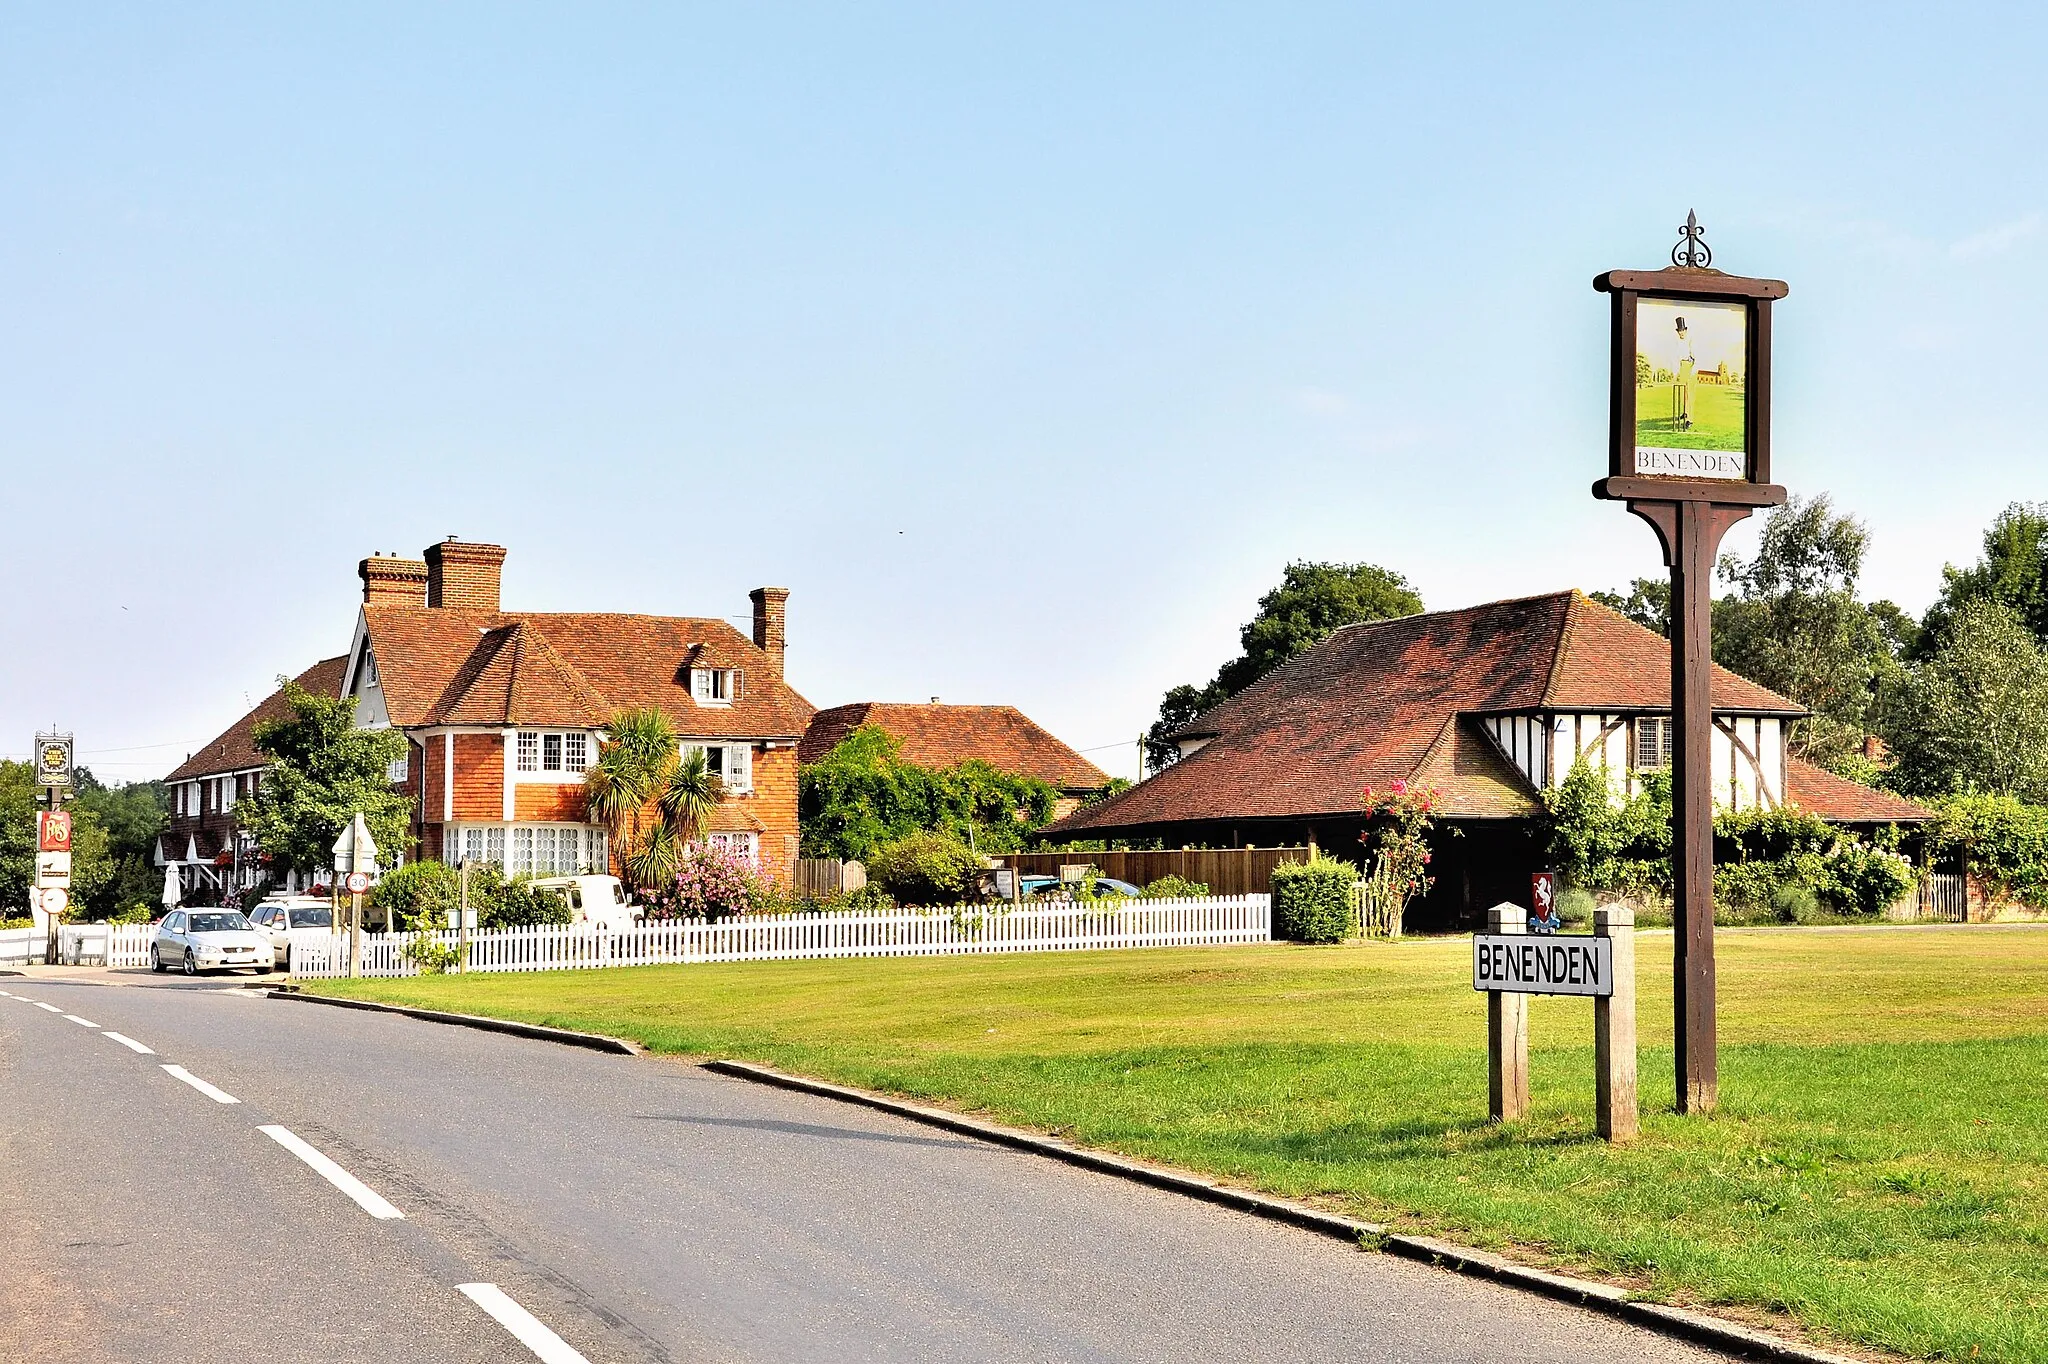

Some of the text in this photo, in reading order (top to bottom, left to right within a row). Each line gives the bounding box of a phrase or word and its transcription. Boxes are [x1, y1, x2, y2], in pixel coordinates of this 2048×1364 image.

[1638, 451, 1742, 472] BENENDEN
[351, 878, 366, 887] 30
[1478, 943, 1599, 985] BENENDEN
